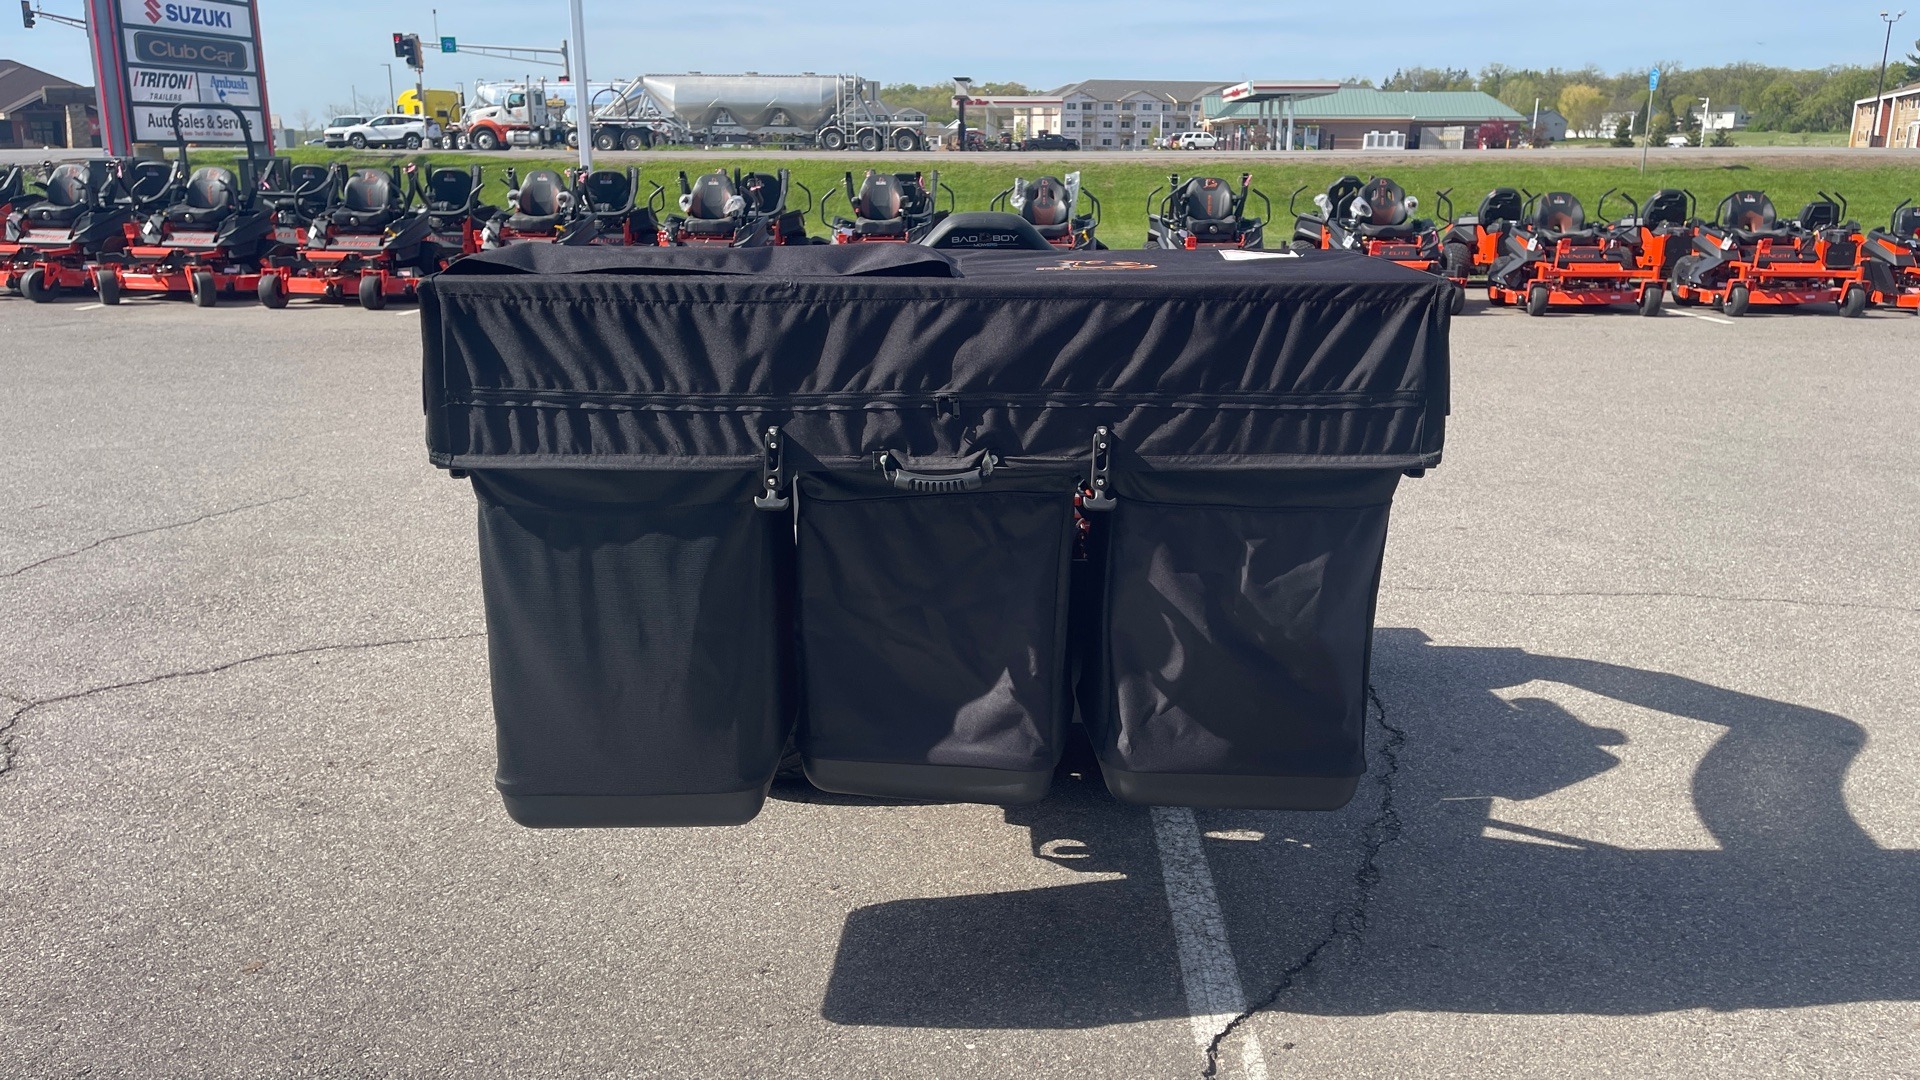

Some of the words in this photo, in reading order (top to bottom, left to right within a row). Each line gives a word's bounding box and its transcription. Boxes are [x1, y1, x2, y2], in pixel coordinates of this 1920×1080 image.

[165, 3, 232, 28] SUZUKI
[148, 40, 198, 60] Club
[201, 45, 235, 64] Car
[140, 71, 188, 90] TRITON
[210, 75, 249, 90] Ambush
[150, 92, 182, 102] TRAILERS
[148, 113, 174, 128] Auto
[177, 113, 205, 129] Sales
[207, 115, 215, 129] &
[217, 115, 253, 130] Serve
[951, 235, 978, 243] BAD
[992, 234, 1019, 242] BOY
